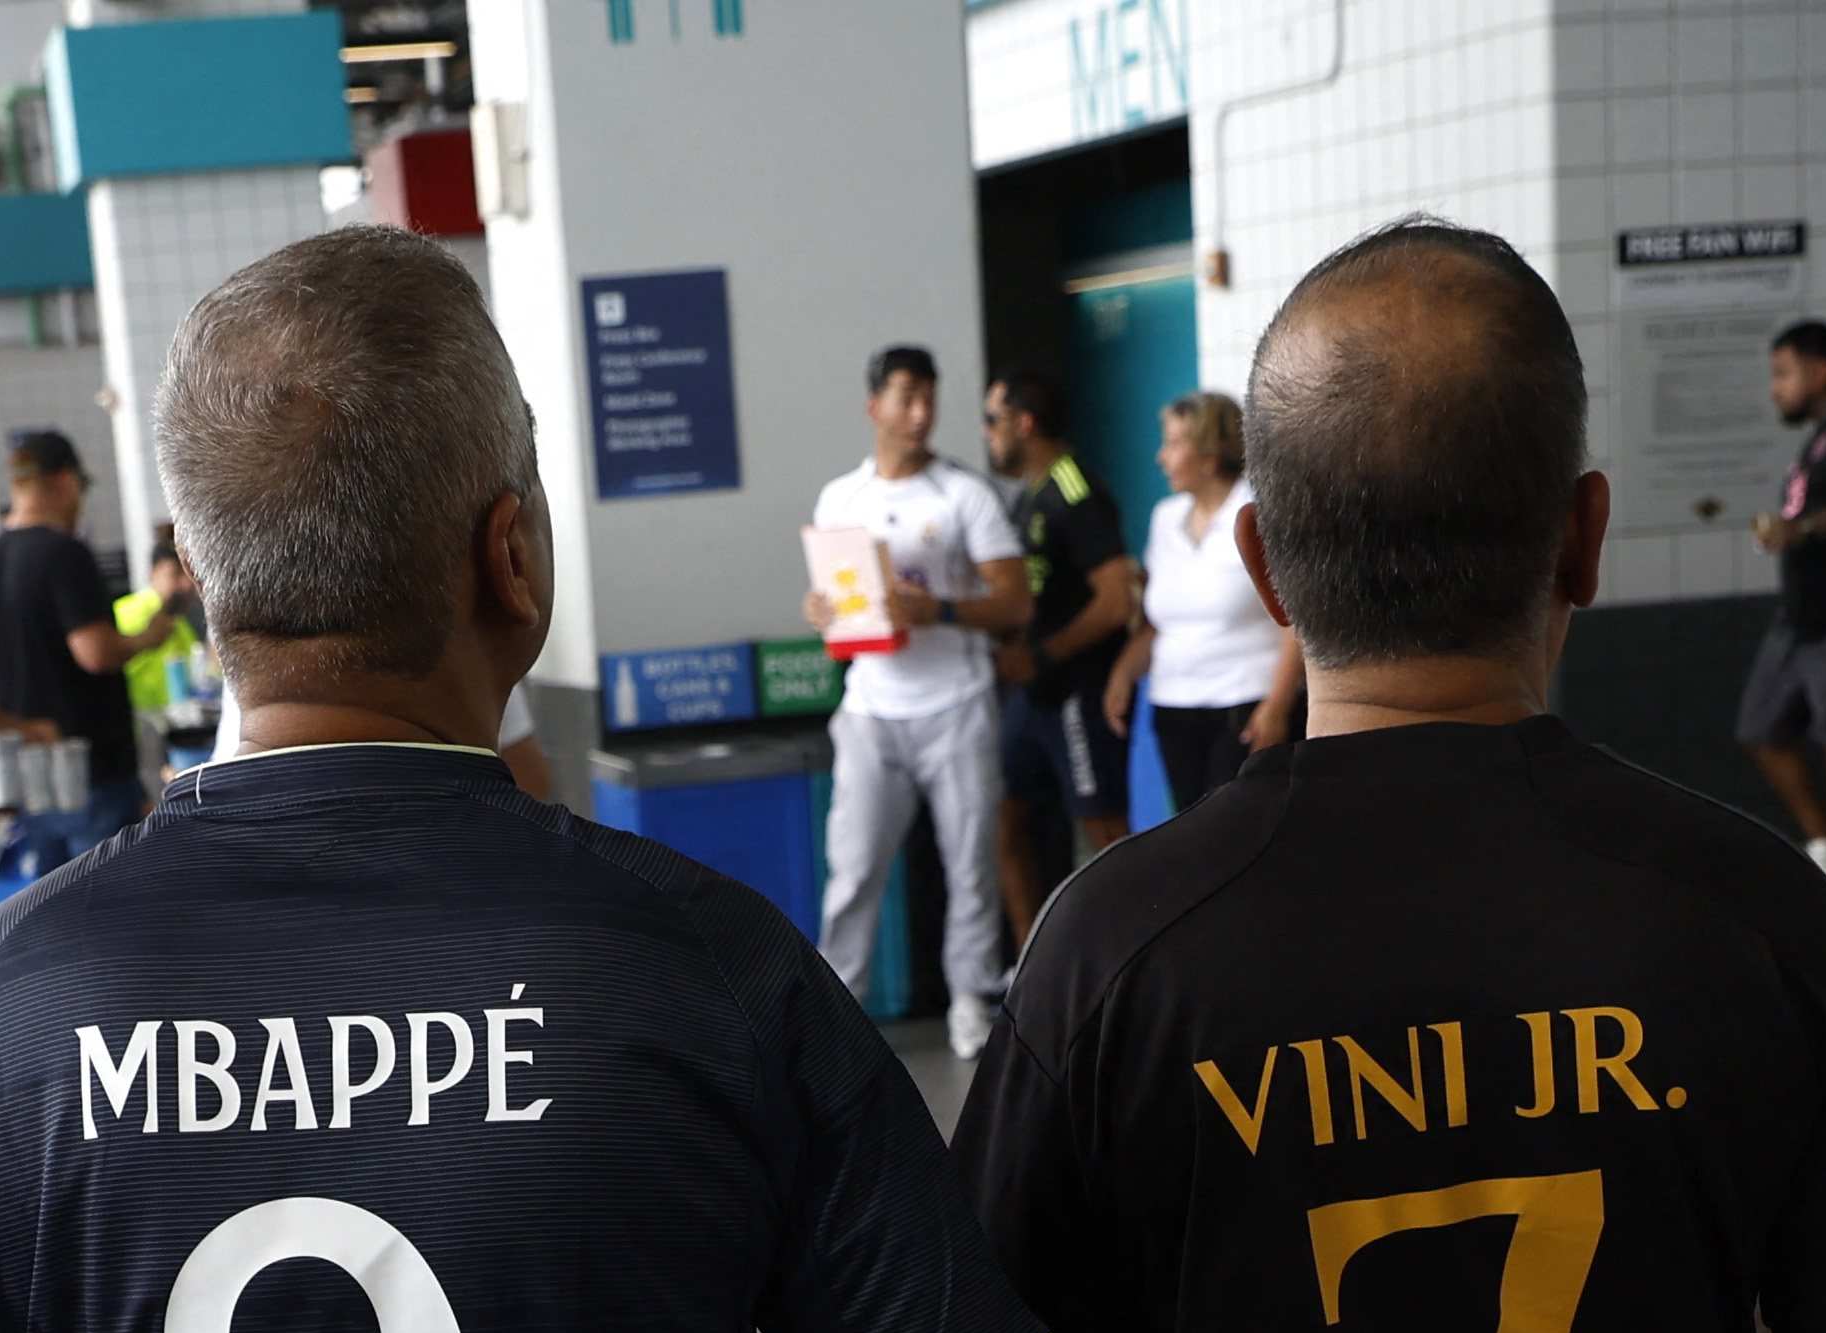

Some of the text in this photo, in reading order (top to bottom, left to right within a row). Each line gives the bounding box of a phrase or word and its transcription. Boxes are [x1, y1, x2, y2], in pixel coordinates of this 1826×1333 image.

[1070, 0, 1189, 142] MEN
[74, 982, 553, 1140] MBAPPÉ
[1193, 1005, 1687, 1156] VINI JR.
